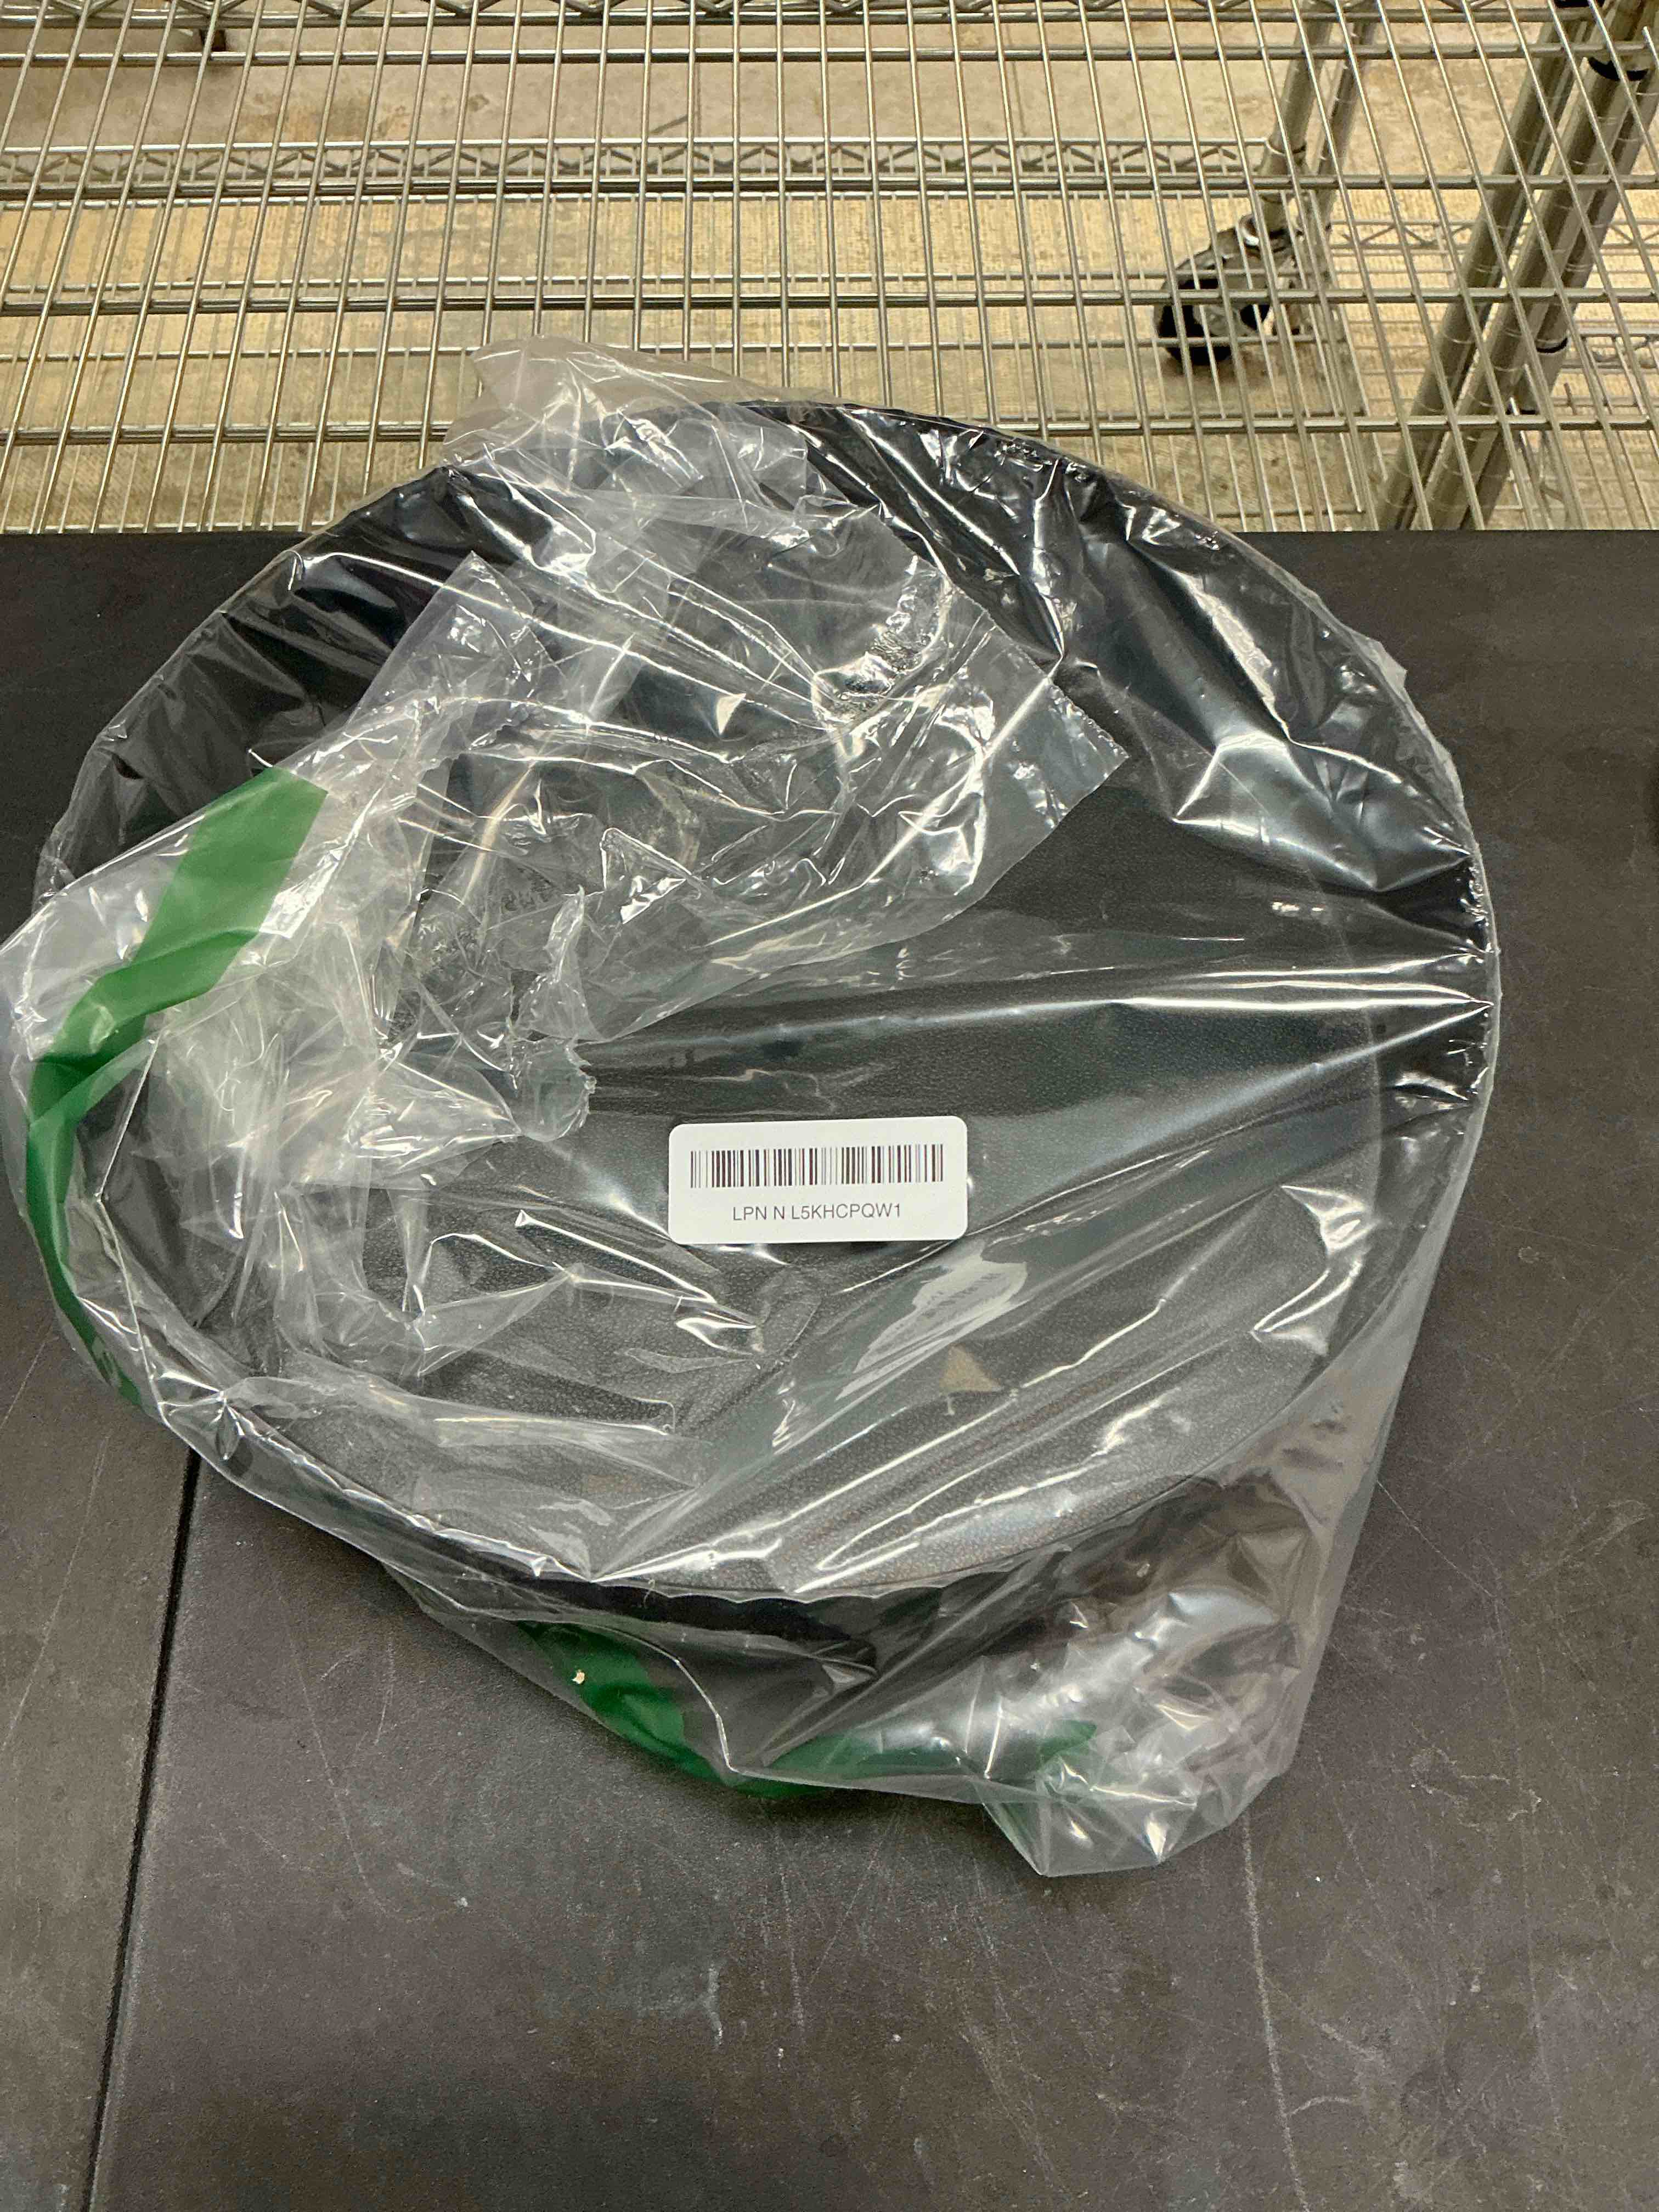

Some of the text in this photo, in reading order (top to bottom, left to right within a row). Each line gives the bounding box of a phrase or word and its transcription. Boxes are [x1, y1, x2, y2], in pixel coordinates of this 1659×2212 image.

[732, 1203, 901, 1221] LPN N L5KHCPQW1
